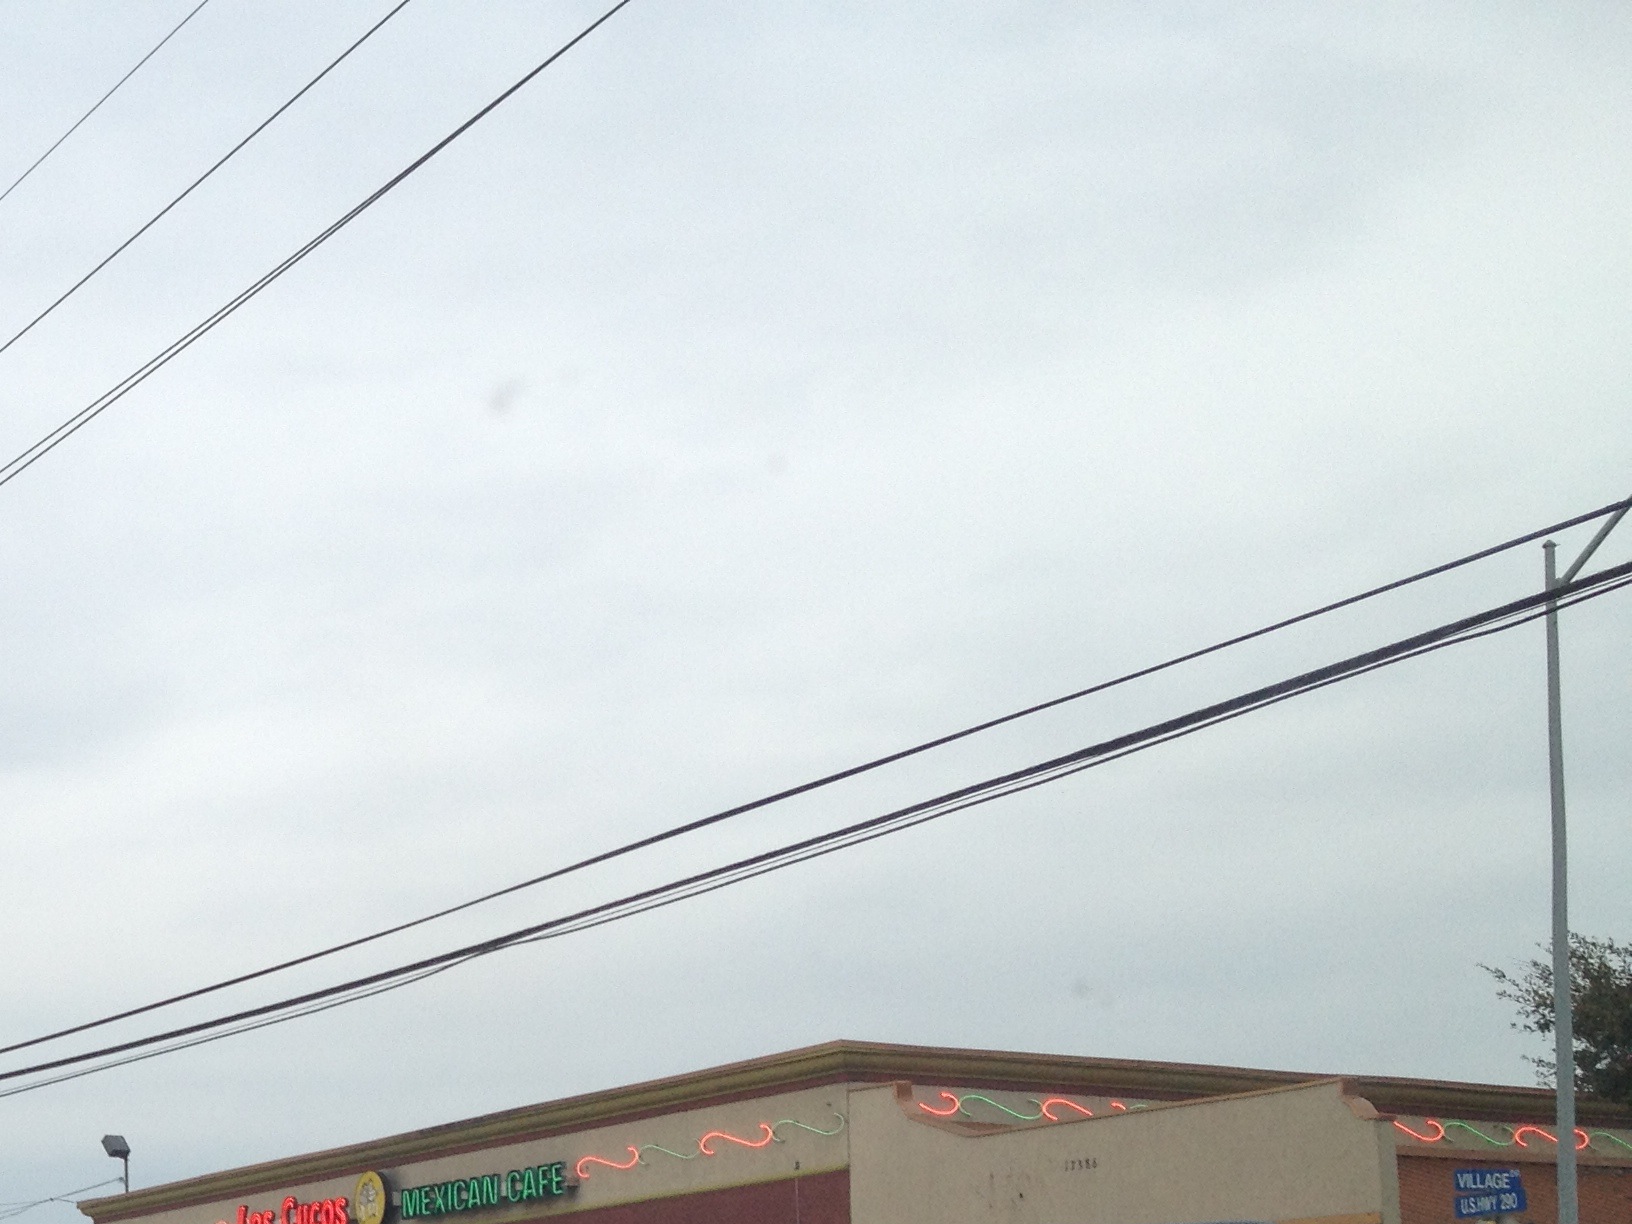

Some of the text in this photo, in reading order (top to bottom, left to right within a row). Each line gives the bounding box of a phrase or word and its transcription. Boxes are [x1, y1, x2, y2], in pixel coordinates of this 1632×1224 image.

[1457, 1173, 1510, 1189] VILLAGE
[401, 1161, 565, 1220] MEXICAN CAFE
[1500, 1192, 1518, 1210] 290
